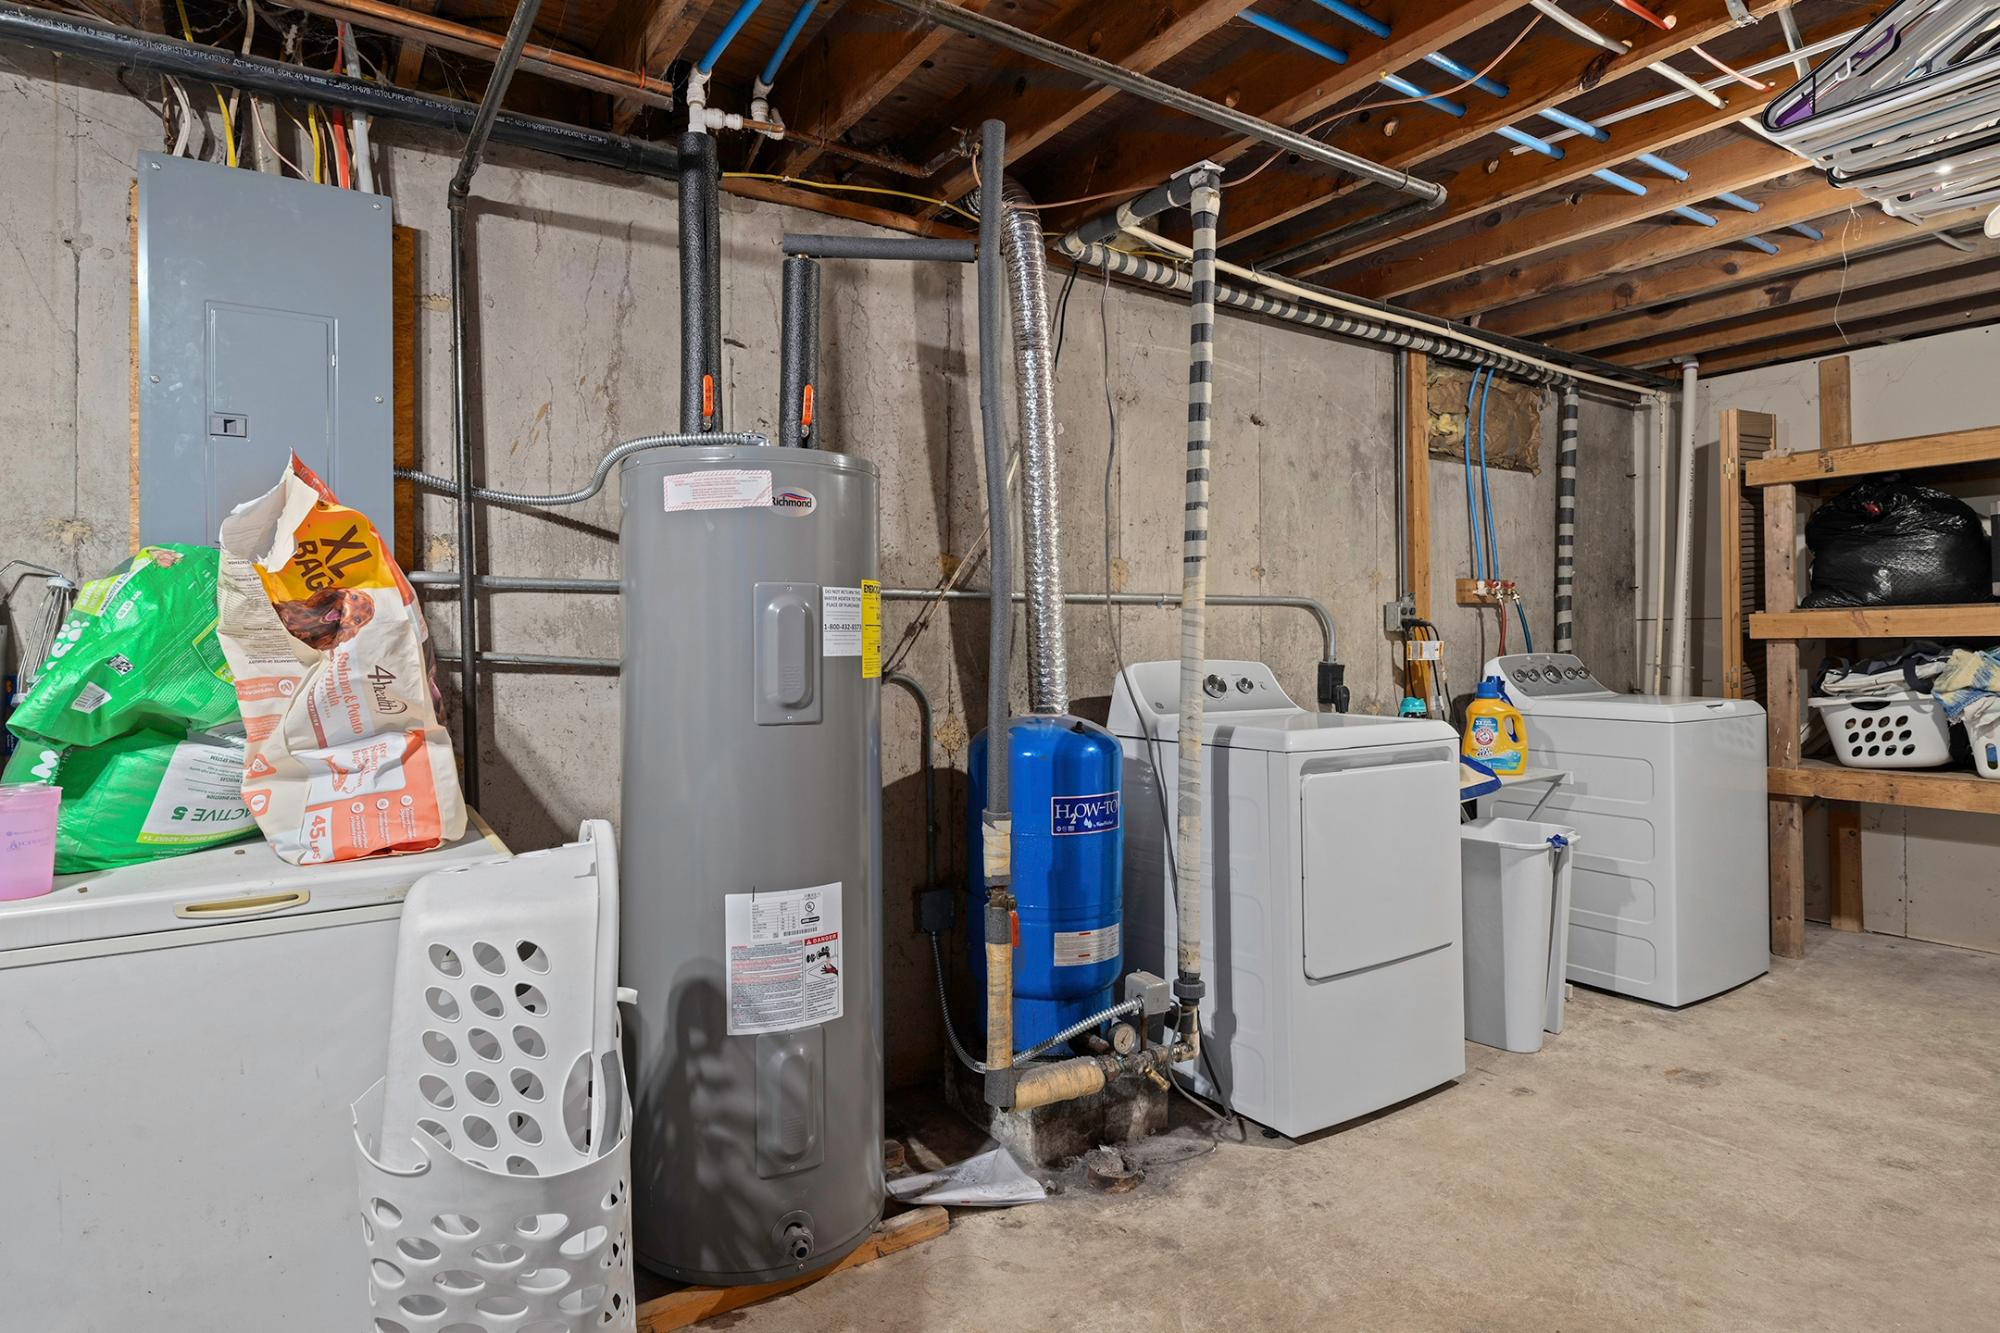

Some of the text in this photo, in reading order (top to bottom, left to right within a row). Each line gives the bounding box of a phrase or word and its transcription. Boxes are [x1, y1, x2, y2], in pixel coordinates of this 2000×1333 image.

[772, 495, 812, 508] Richmond
[294, 540, 336, 593] BAG
[319, 524, 373, 580] XL
[337, 652, 358, 697] Salmon
[367, 664, 407, 714] 4health
[344, 695, 359, 704] &
[346, 704, 365, 735] Potato
[171, 806, 188, 821] 5
[308, 814, 326, 860] 45 LBS
[812, 933, 837, 945] DANGER
